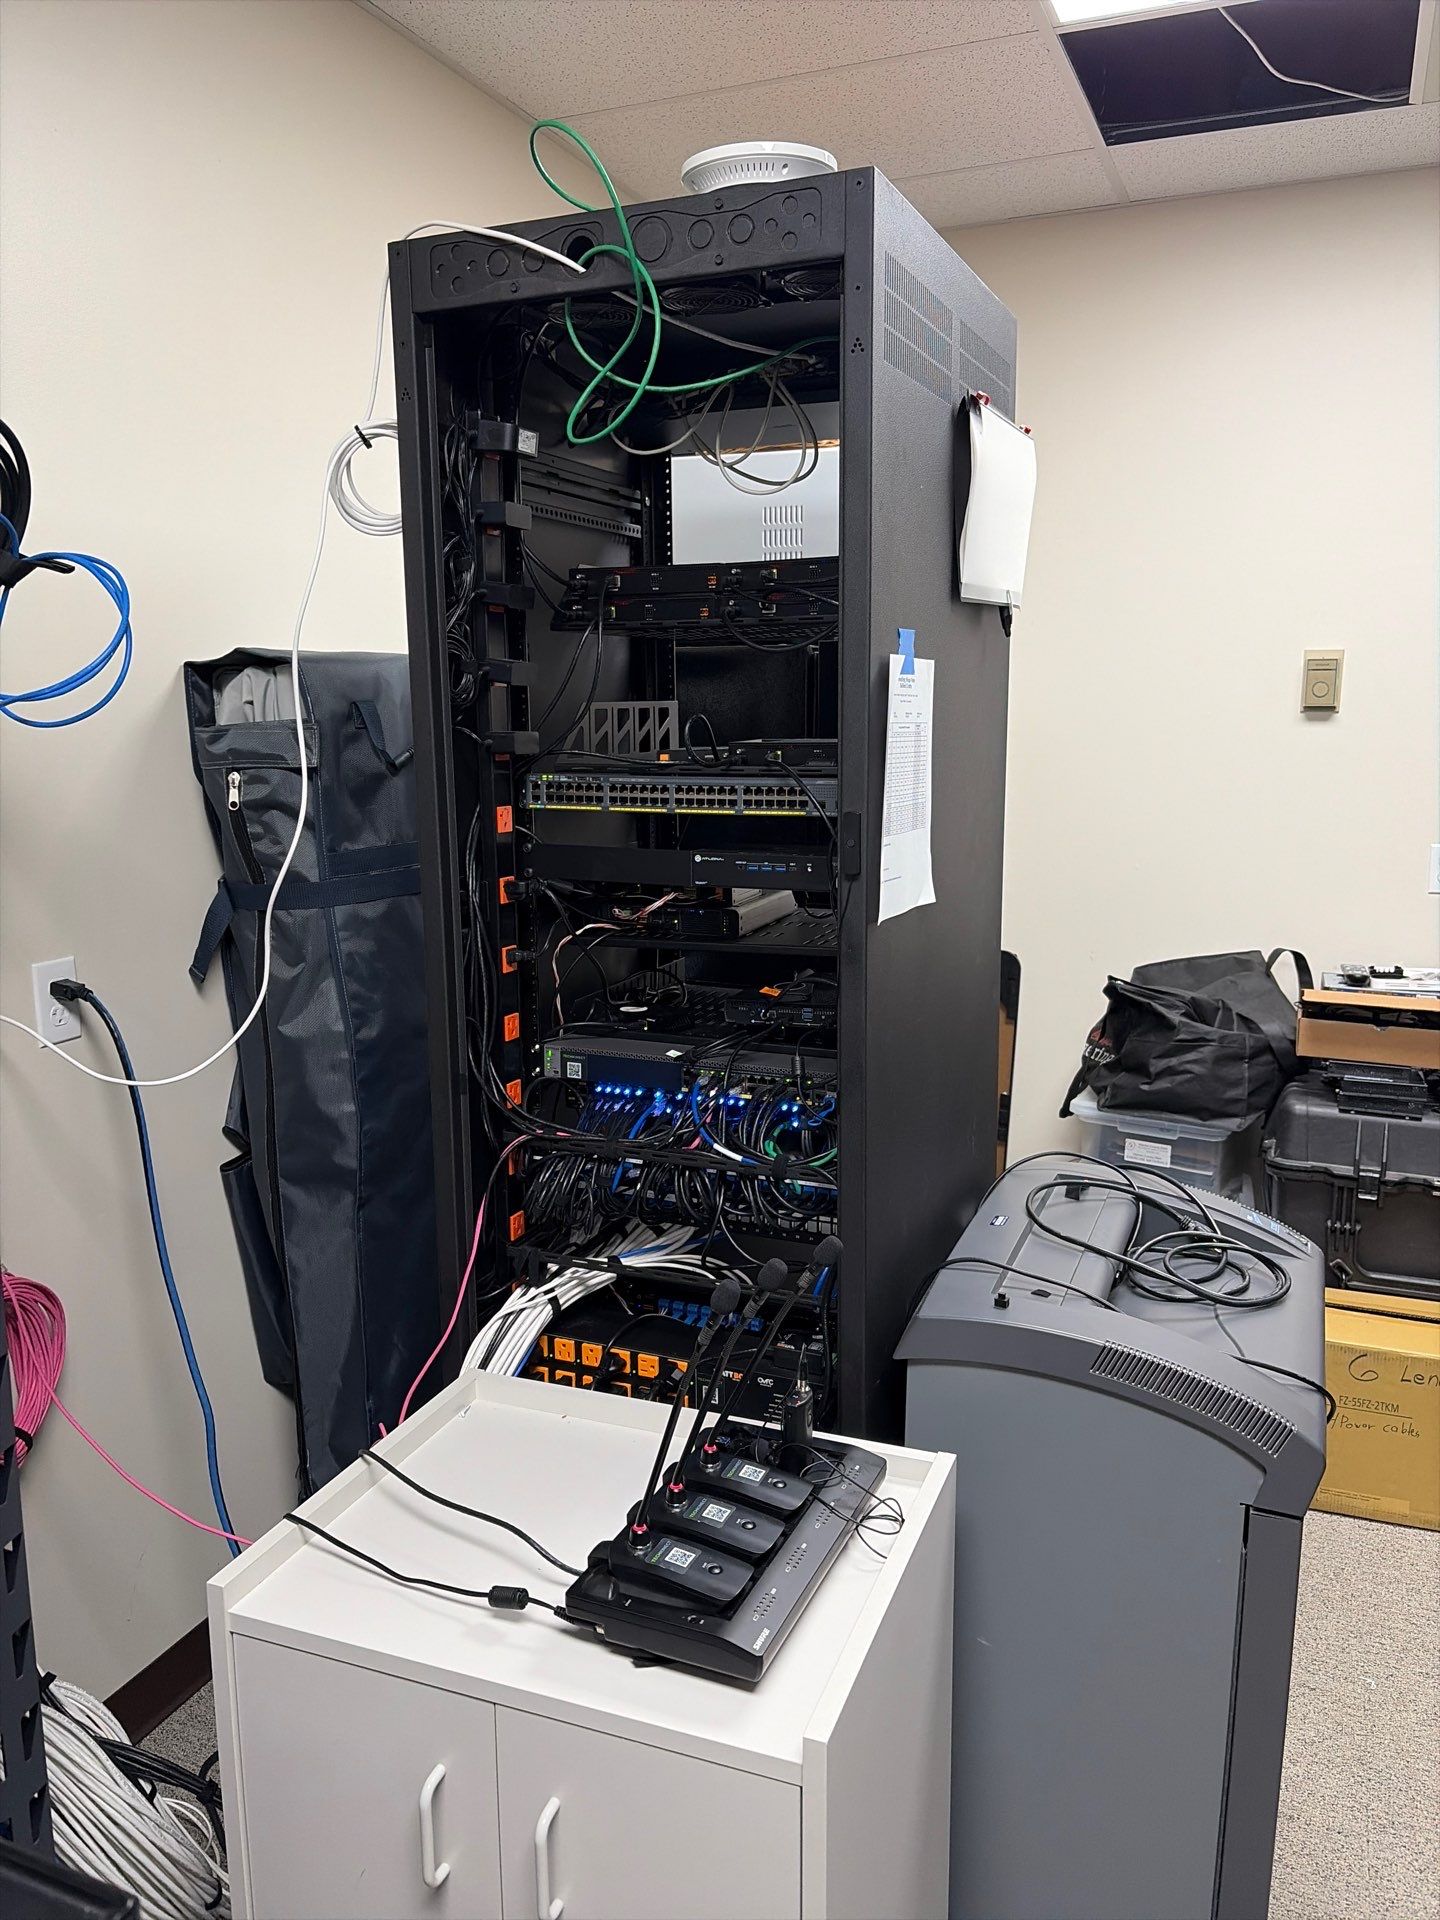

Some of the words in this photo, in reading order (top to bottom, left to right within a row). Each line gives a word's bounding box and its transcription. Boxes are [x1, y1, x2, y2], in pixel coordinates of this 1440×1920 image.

[1348, 1353, 1379, 1382] 6
[1400, 1364, 1440, 1387] Len
[1338, 1395, 1400, 1413] FZ-55FZ-2TKM
[1382, 1421, 1420, 1438] cables
[753, 1627, 770, 1650] SHURE
